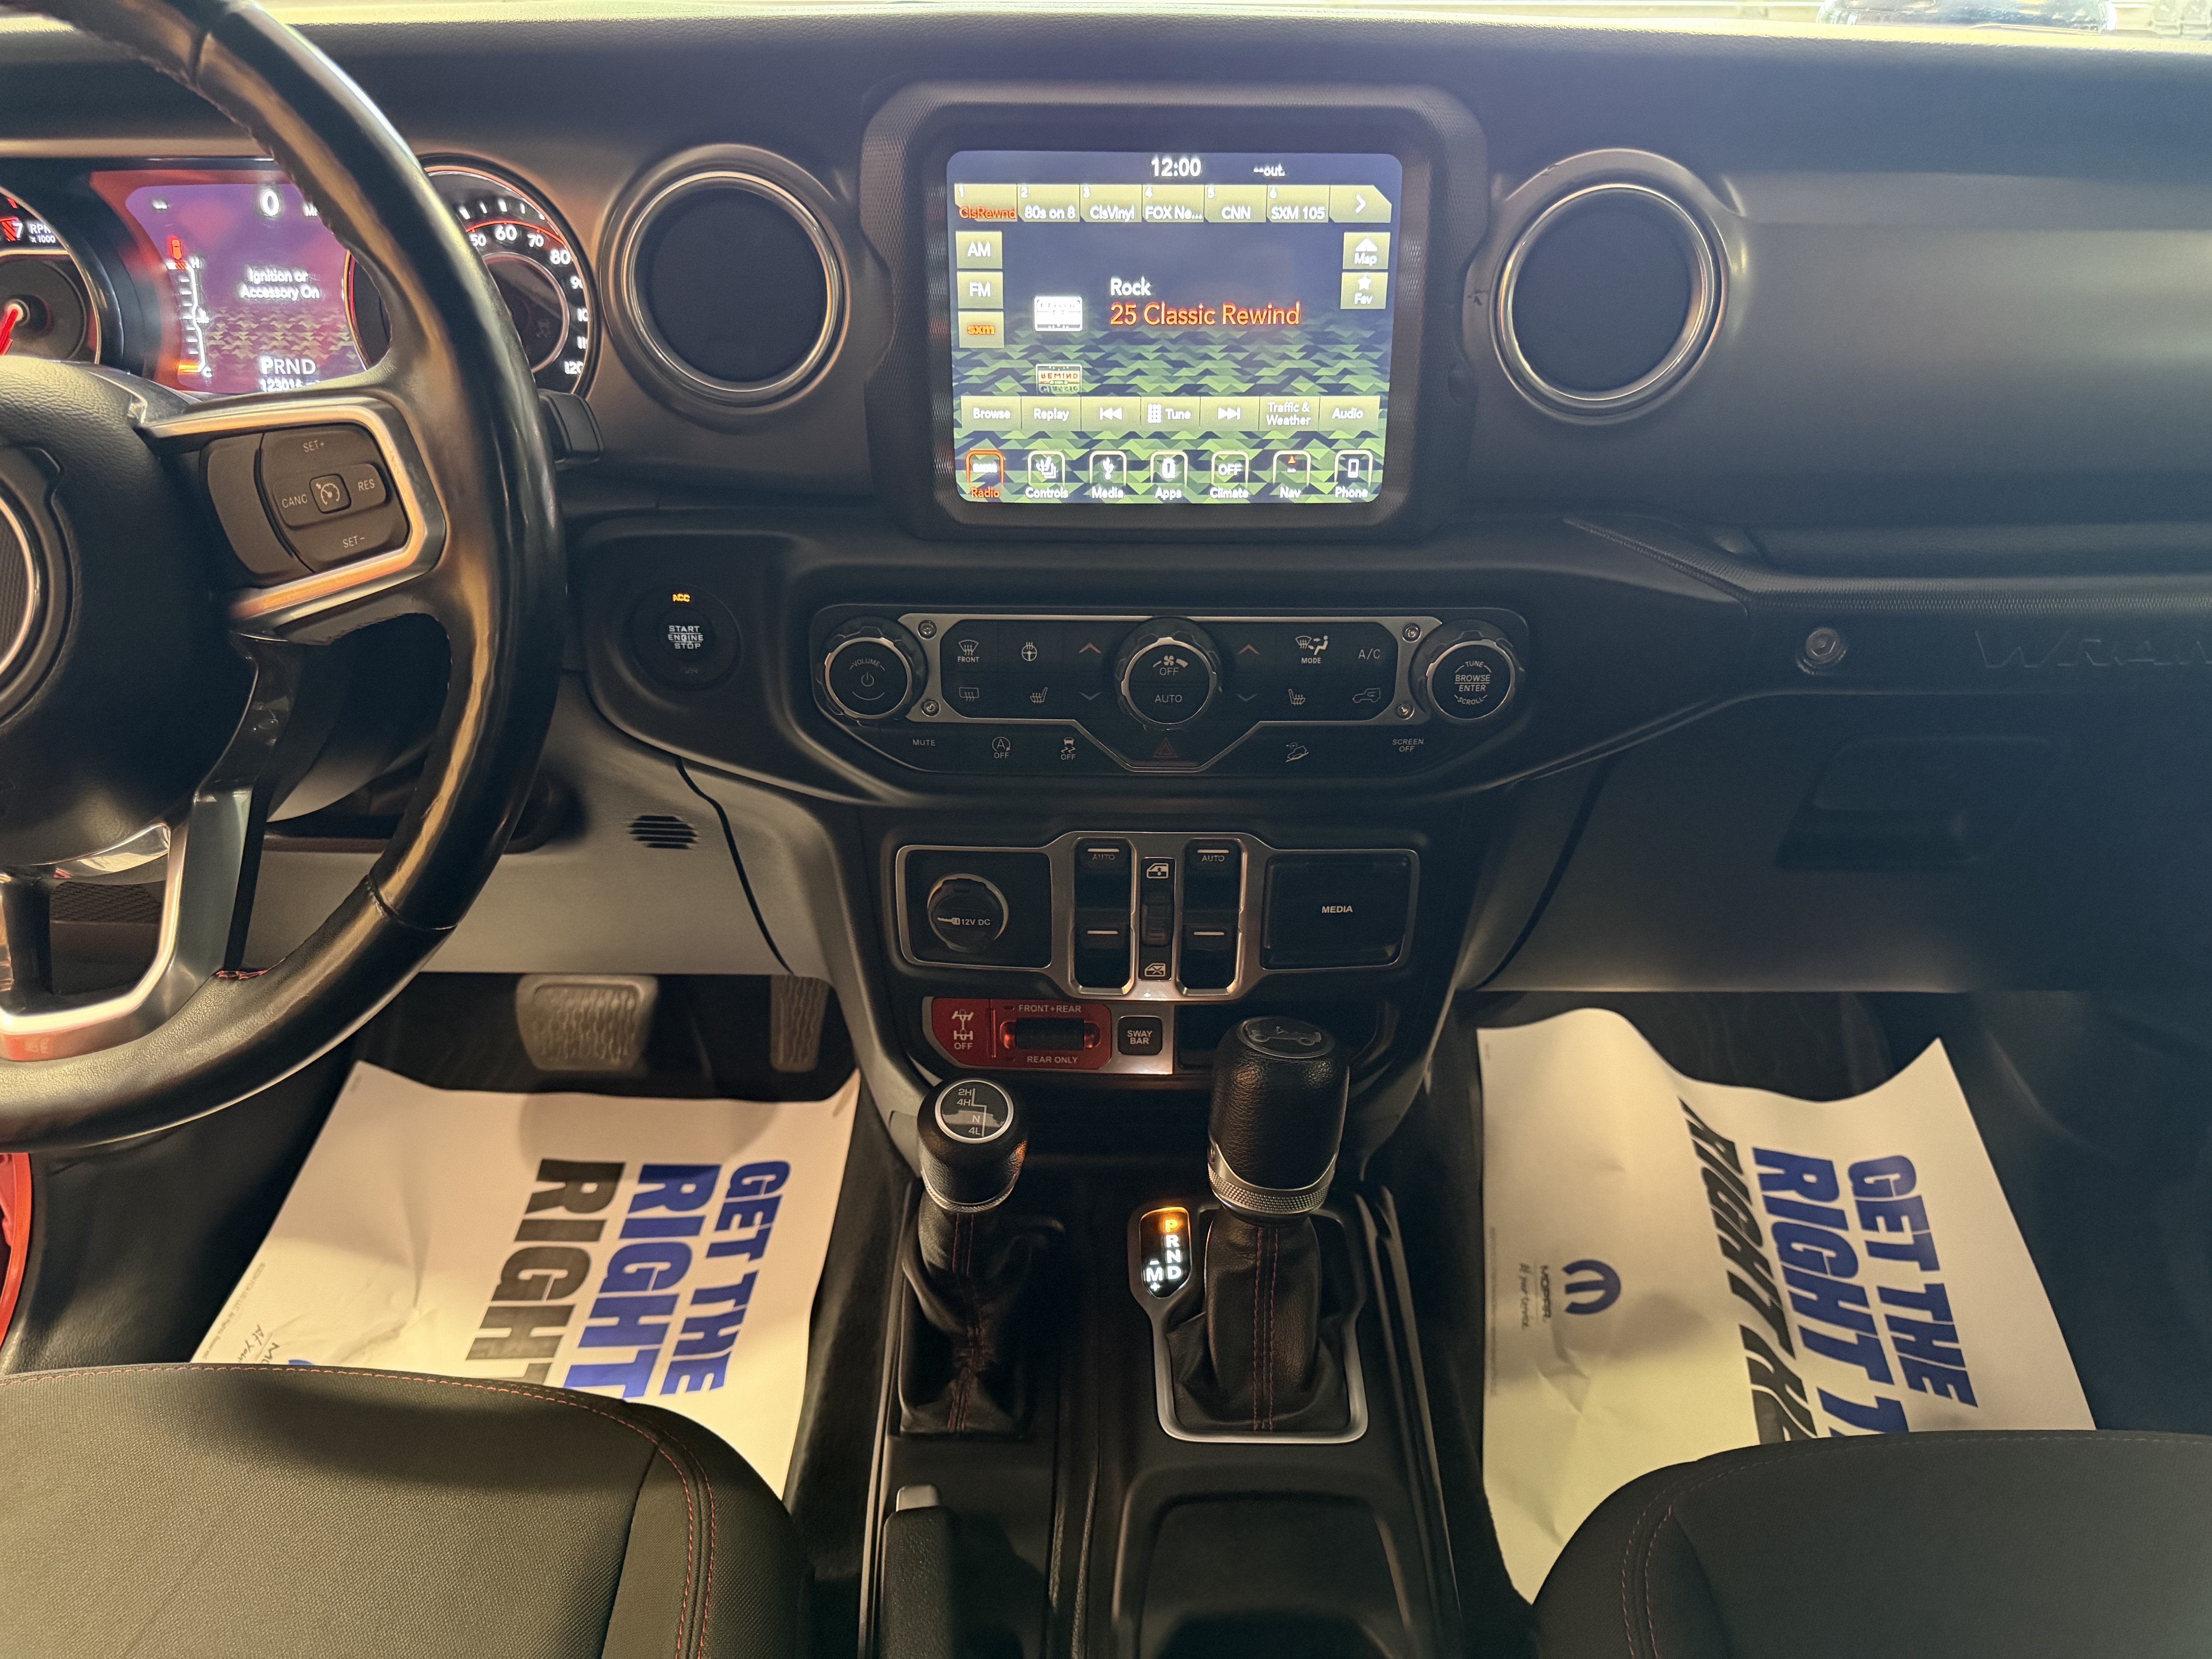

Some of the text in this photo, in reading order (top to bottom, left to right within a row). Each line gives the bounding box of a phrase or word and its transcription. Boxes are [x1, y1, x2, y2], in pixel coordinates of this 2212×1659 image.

[1151, 157, 1202, 177] 12:00
[958, 186, 964, 198] 1
[1020, 187, 1028, 198] 2
[1083, 187, 1090, 198] 3
[1145, 187, 1152, 198] 4
[1207, 187, 1214, 198] 5
[1269, 187, 1277, 198] 6
[262, 191, 280, 216] 0
[959, 205, 1017, 220] ClsRewnd
[1025, 206, 1075, 220] 80s on 8
[1090, 205, 1135, 222] ClsVinyl
[1145, 206, 1171, 220] FOX
[1221, 206, 1250, 220] CNN
[1271, 206, 1325, 220] SXM 105
[38, 235, 56, 243] 1000
[496, 225, 518, 241] 60
[470, 233, 486, 247] 50
[527, 233, 544, 247] 70
[967, 242, 991, 257] AM
[550, 249, 571, 265] 80
[1355, 253, 1377, 267] Map
[248, 270, 309, 283] Ignition or
[969, 282, 991, 297] FM
[1110, 276, 1151, 296] Rock
[241, 286, 320, 301] Accessory On
[1355, 293, 1373, 305] Fav
[577, 308, 589, 322] 10
[1111, 301, 1300, 326] 25 Classic Rewind
[967, 324, 996, 335] sxm
[577, 336, 588, 349] 11
[261, 356, 316, 374] PRND
[973, 407, 1011, 419] Browse
[1166, 408, 1192, 420] Tune
[1268, 402, 1310, 414] Traffic &
[1332, 407, 1364, 420] Audio
[1034, 408, 1070, 422] Replay
[1266, 414, 1311, 426] Weather
[1218, 464, 1242, 476] OFF
[358, 479, 375, 491] RES
[970, 486, 1000, 498] Radio
[1025, 487, 1069, 499] Controls
[1092, 487, 1123, 499] Media
[1154, 487, 1182, 500] Apps
[1210, 487, 1249, 499] Climate
[1279, 487, 1302, 499] Nav
[1335, 486, 1369, 499] Phone
[282, 494, 308, 508] CANC
[672, 594, 690, 602] ACC
[1358, 648, 1381, 660] A/C
[852, 658, 881, 668] VOLUME
[1465, 660, 1485, 668] TUNE
[1159, 668, 1179, 676] OFF
[1455, 674, 1491, 682] BROWSE
[1154, 695, 1182, 703] AUTO
[1456, 697, 1484, 706] SCROLL
[1321, 905, 1353, 914] MEDIA
[1127, 1030, 1153, 1039] SWAY
[969, 1127, 981, 1135] 4L
[1165, 1219, 1178, 1232] P
[1678, 1096, 1796, 1360] RIGHT
[1166, 1235, 1180, 1248] R
[1166, 1249, 1181, 1263] N
[1167, 1266, 1181, 1279] D
[1752, 1147, 1895, 1386] RIGHT
[659, 1161, 791, 1396] GET THE
[1146, 1267, 1162, 1282] M
[1848, 1154, 1978, 1408] GET THE
[562, 1164, 723, 1399] RIGHT
